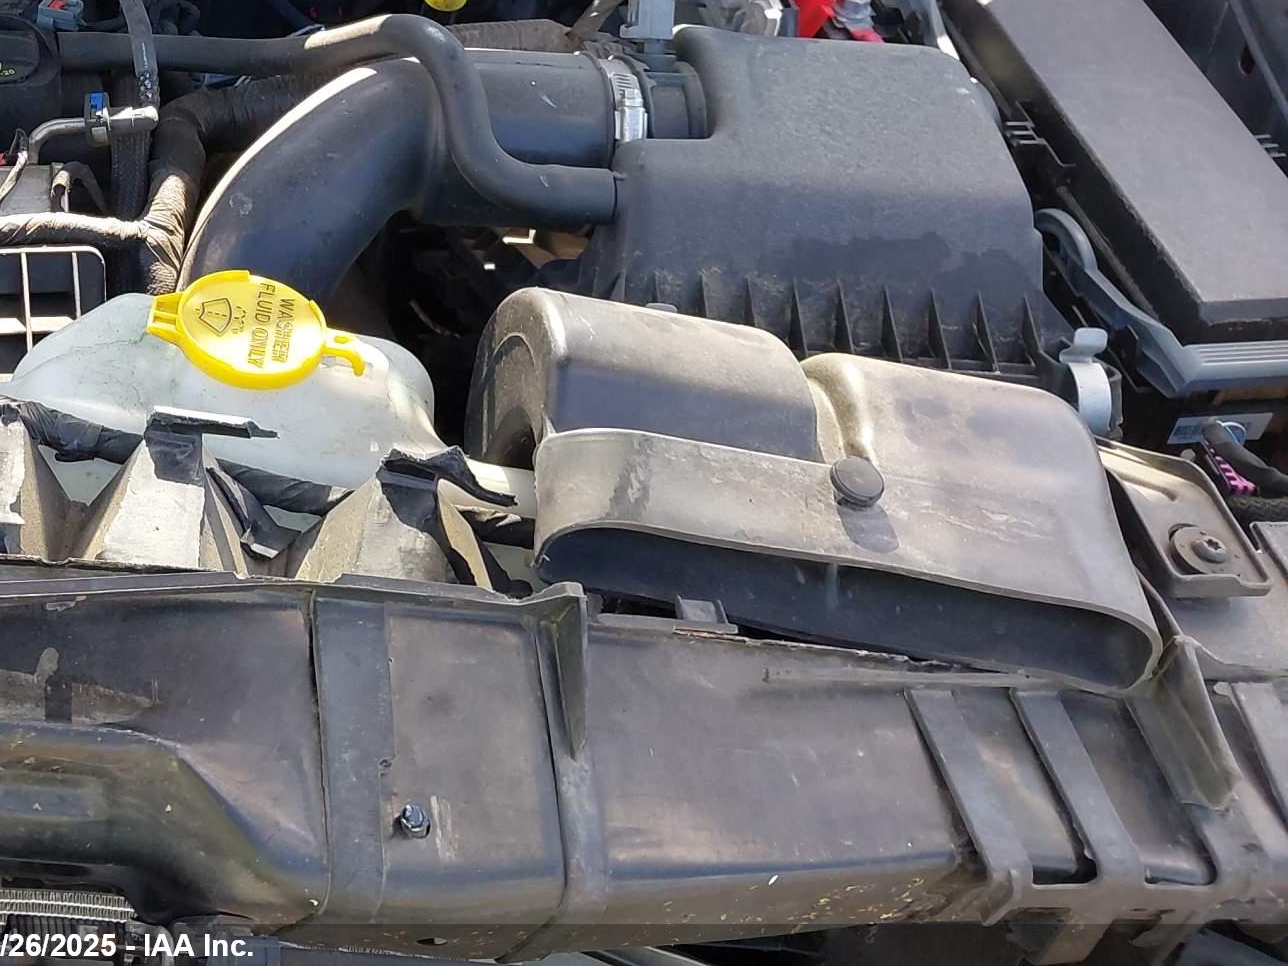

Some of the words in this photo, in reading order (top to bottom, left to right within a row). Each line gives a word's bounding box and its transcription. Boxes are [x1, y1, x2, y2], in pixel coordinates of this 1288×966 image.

[254, 282, 276, 324] FLUID
[247, 327, 269, 369] ONLY
[271, 298, 296, 363] WASHER
